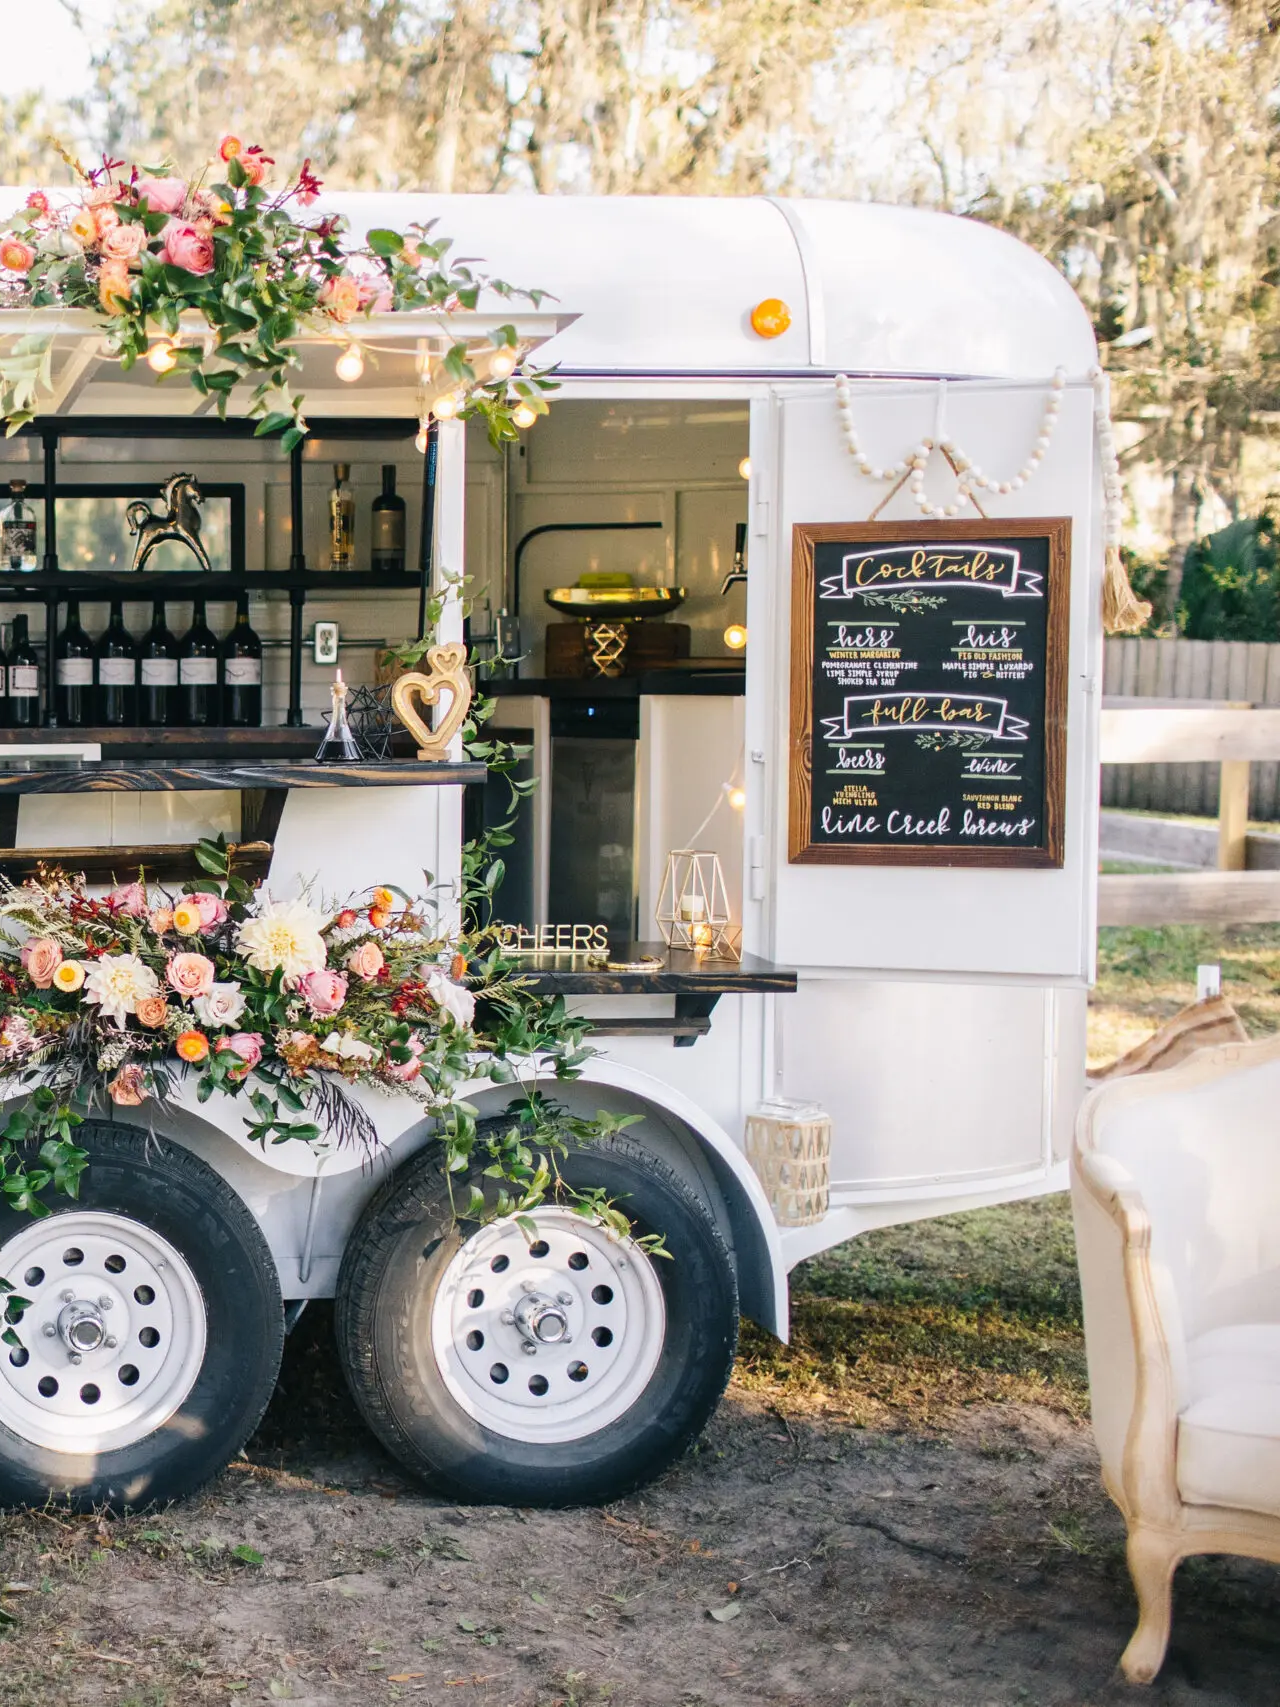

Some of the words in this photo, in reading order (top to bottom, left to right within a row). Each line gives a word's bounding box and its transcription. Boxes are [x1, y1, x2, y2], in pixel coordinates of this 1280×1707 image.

[856, 551, 1004, 586] Cocktails
[833, 626, 894, 648] hers
[959, 625, 1017, 648] his
[829, 651, 858, 659] WINTER
[860, 651, 901, 659] MARGARITA
[959, 652, 973, 660] FIG
[974, 652, 987, 660] OLD
[988, 652, 1023, 661] FASHION
[821, 661, 871, 669] POMEGRANATE
[873, 661, 918, 670] CLEMENTINE
[942, 662, 966, 670] MAPLE
[968, 662, 994, 670] SIMPLE
[999, 662, 1034, 670] LUXARDO
[826, 670, 845, 678] LIME
[847, 670, 873, 678] SIMPLE
[876, 670, 900, 678] SYRUP
[963, 671, 978, 679] FIG
[995, 671, 1026, 679] BITTERS
[838, 677, 864, 686] SMOKED
[865, 678, 878, 686] SEA
[880, 678, 897, 686] SALT
[861, 697, 930, 726] full
[933, 698, 992, 722] bar
[836, 747, 886, 769] beers
[964, 758, 1017, 774] wine
[835, 791, 877, 799] YUENGLING
[962, 793, 1000, 802] SAUVIGNON
[1001, 794, 1023, 803] BLANC
[832, 798, 852, 806] MICH
[854, 798, 879, 807] ULTRA
[977, 802, 991, 810] RED
[993, 802, 1016, 811] BLEND
[821, 806, 881, 834] line
[886, 808, 951, 836] Creek
[959, 808, 1036, 837] brews
[497, 923, 608, 950] CHEERS
